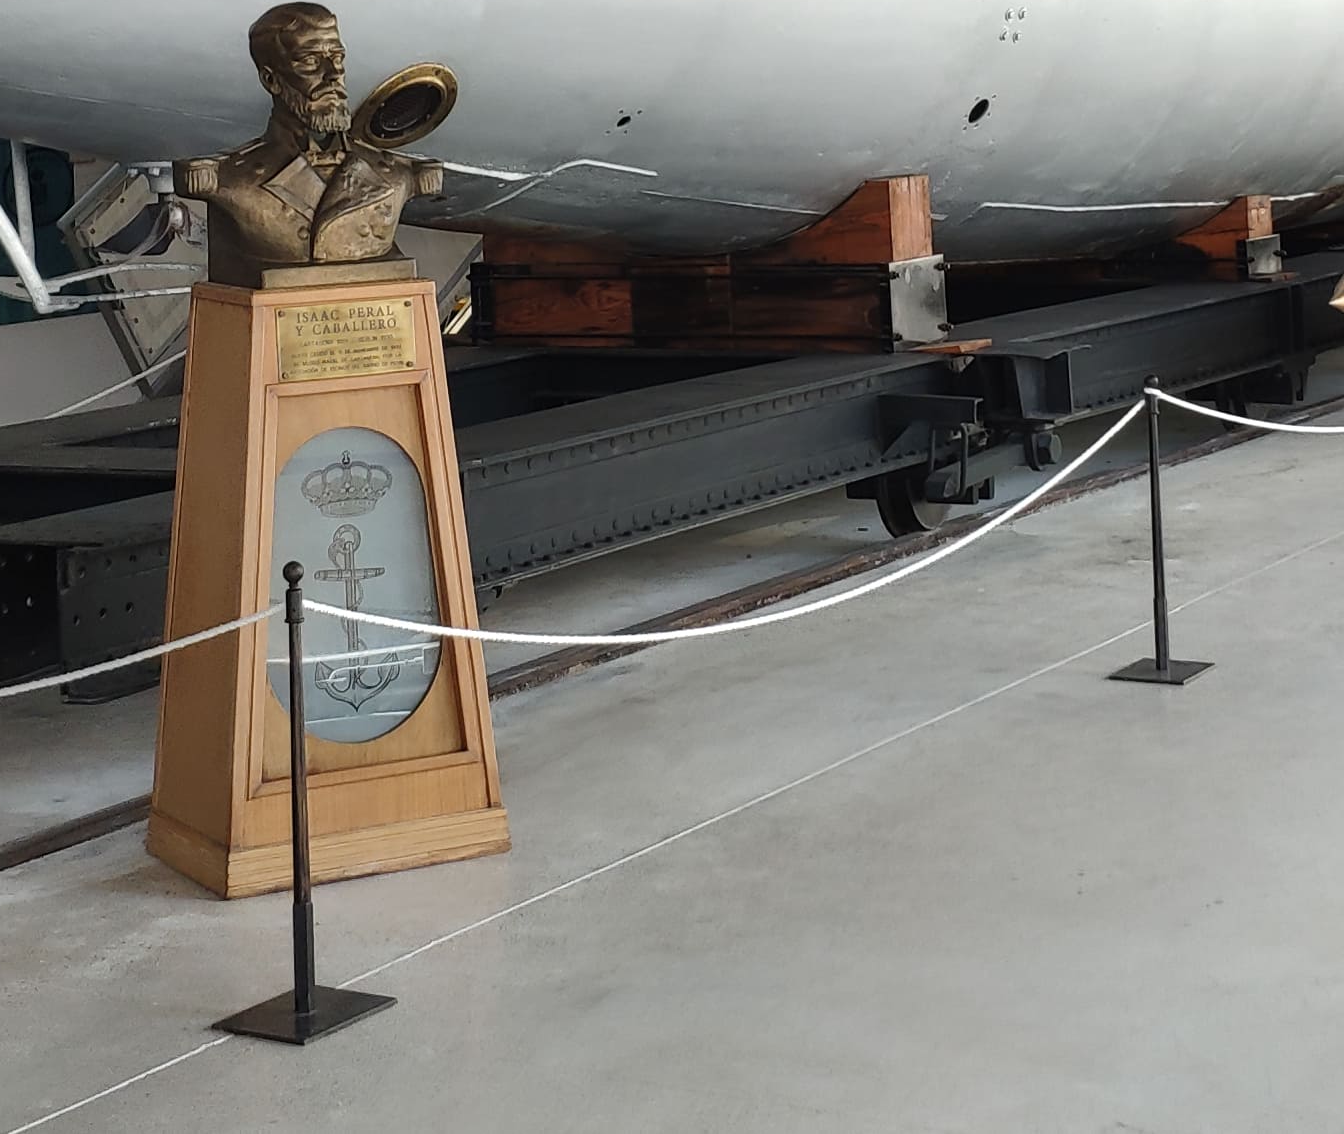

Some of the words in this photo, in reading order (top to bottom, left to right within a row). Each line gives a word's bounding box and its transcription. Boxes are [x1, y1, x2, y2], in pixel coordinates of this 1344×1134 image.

[296, 309, 340, 323] ISAAC
[348, 305, 394, 319] PERAL
[296, 325, 304, 337] Y
[312, 317, 397, 336] CABALLERO
